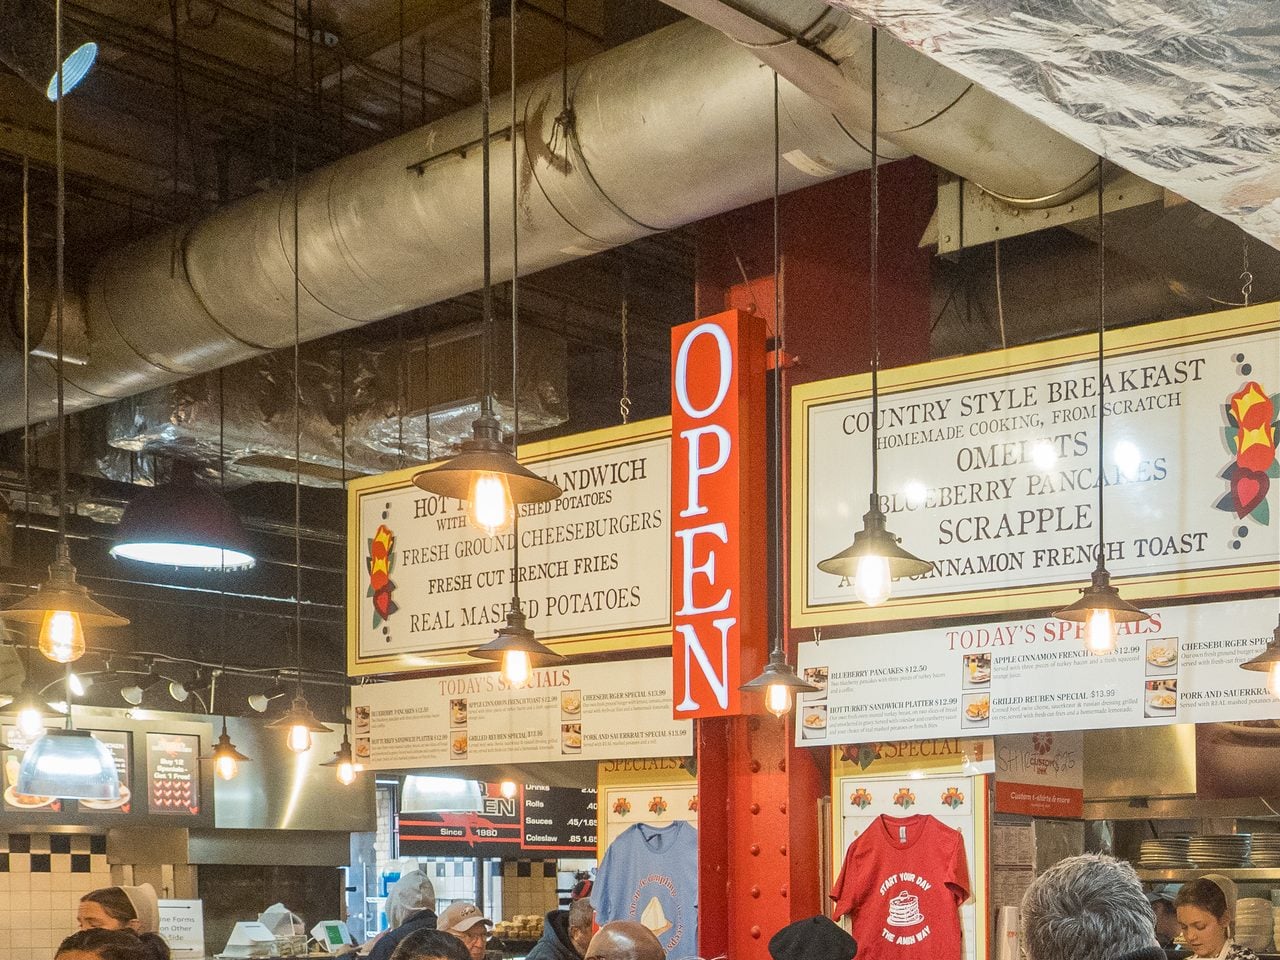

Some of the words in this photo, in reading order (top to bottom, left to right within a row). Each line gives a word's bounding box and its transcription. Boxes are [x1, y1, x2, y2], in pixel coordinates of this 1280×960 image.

[842, 399, 951, 435] COUNTRY
[960, 384, 1038, 417] STYLE
[1047, 358, 1206, 403] BREAKFAST
[877, 423, 964, 450] HOMEMADE
[970, 413, 1044, 437] COOKING,
[1052, 405, 1097, 425] FROM
[1101, 392, 1182, 418] SCRATCH
[956, 431, 1089, 472] OMELTS
[414, 494, 449, 520] HOT
[436, 515, 467, 532] WITH
[554, 489, 613, 513] POTATOES
[675, 323, 737, 711] OPEN
[938, 504, 1093, 545] SCRAPPLE
[402, 544, 450, 567] FRESH
[454, 532, 516, 559] GROUND
[521, 509, 662, 549] CHEESEBURGERS
[1032, 540, 1126, 570] FRENCH
[1133, 532, 1209, 559] TOAST
[428, 573, 471, 595] FRESH
[477, 569, 505, 590] CUT
[509, 560, 568, 584] FRENCH
[573, 553, 619, 576] FRIES
[410, 609, 457, 633] REAL
[461, 600, 539, 627] MASHED
[545, 585, 641, 617] POTATOES
[946, 624, 1036, 651] TODAY'S
[1181, 639, 1248, 651] CHEESEBURGER
[994, 656, 1017, 664] APPLE
[1018, 653, 1057, 662] CINNAMON
[1058, 650, 1089, 659] FRENCH
[831, 670, 869, 680] BLUEBERRY
[870, 667, 904, 677] PANCAKES
[439, 675, 495, 697] TODAY'S
[993, 697, 1024, 706] GRILLED
[1025, 694, 1055, 704] REUBEN
[1056, 692, 1089, 701] SPECIAL
[1090, 689, 1116, 698] $13.99
[1180, 691, 1203, 700] PORK
[1204, 690, 1222, 699] AND
[830, 706, 844, 714] HOT
[844, 704, 868, 713] TURKEY
[869, 701, 904, 711] SANDWICH
[905, 700, 934, 709] PLATTER
[604, 758, 679, 773] SPECIALS
[525, 800, 544, 808] Rolls
[440, 828, 463, 836] Since
[475, 828, 498, 837] 1980
[525, 817, 553, 825] Sauces
[525, 834, 557, 843] Coleslaw
[880, 875, 898, 896] START
[899, 872, 916, 882] YOUR
[916, 876, 932, 891] DAY
[881, 928, 896, 943] THE
[915, 925, 931, 942] WAY
